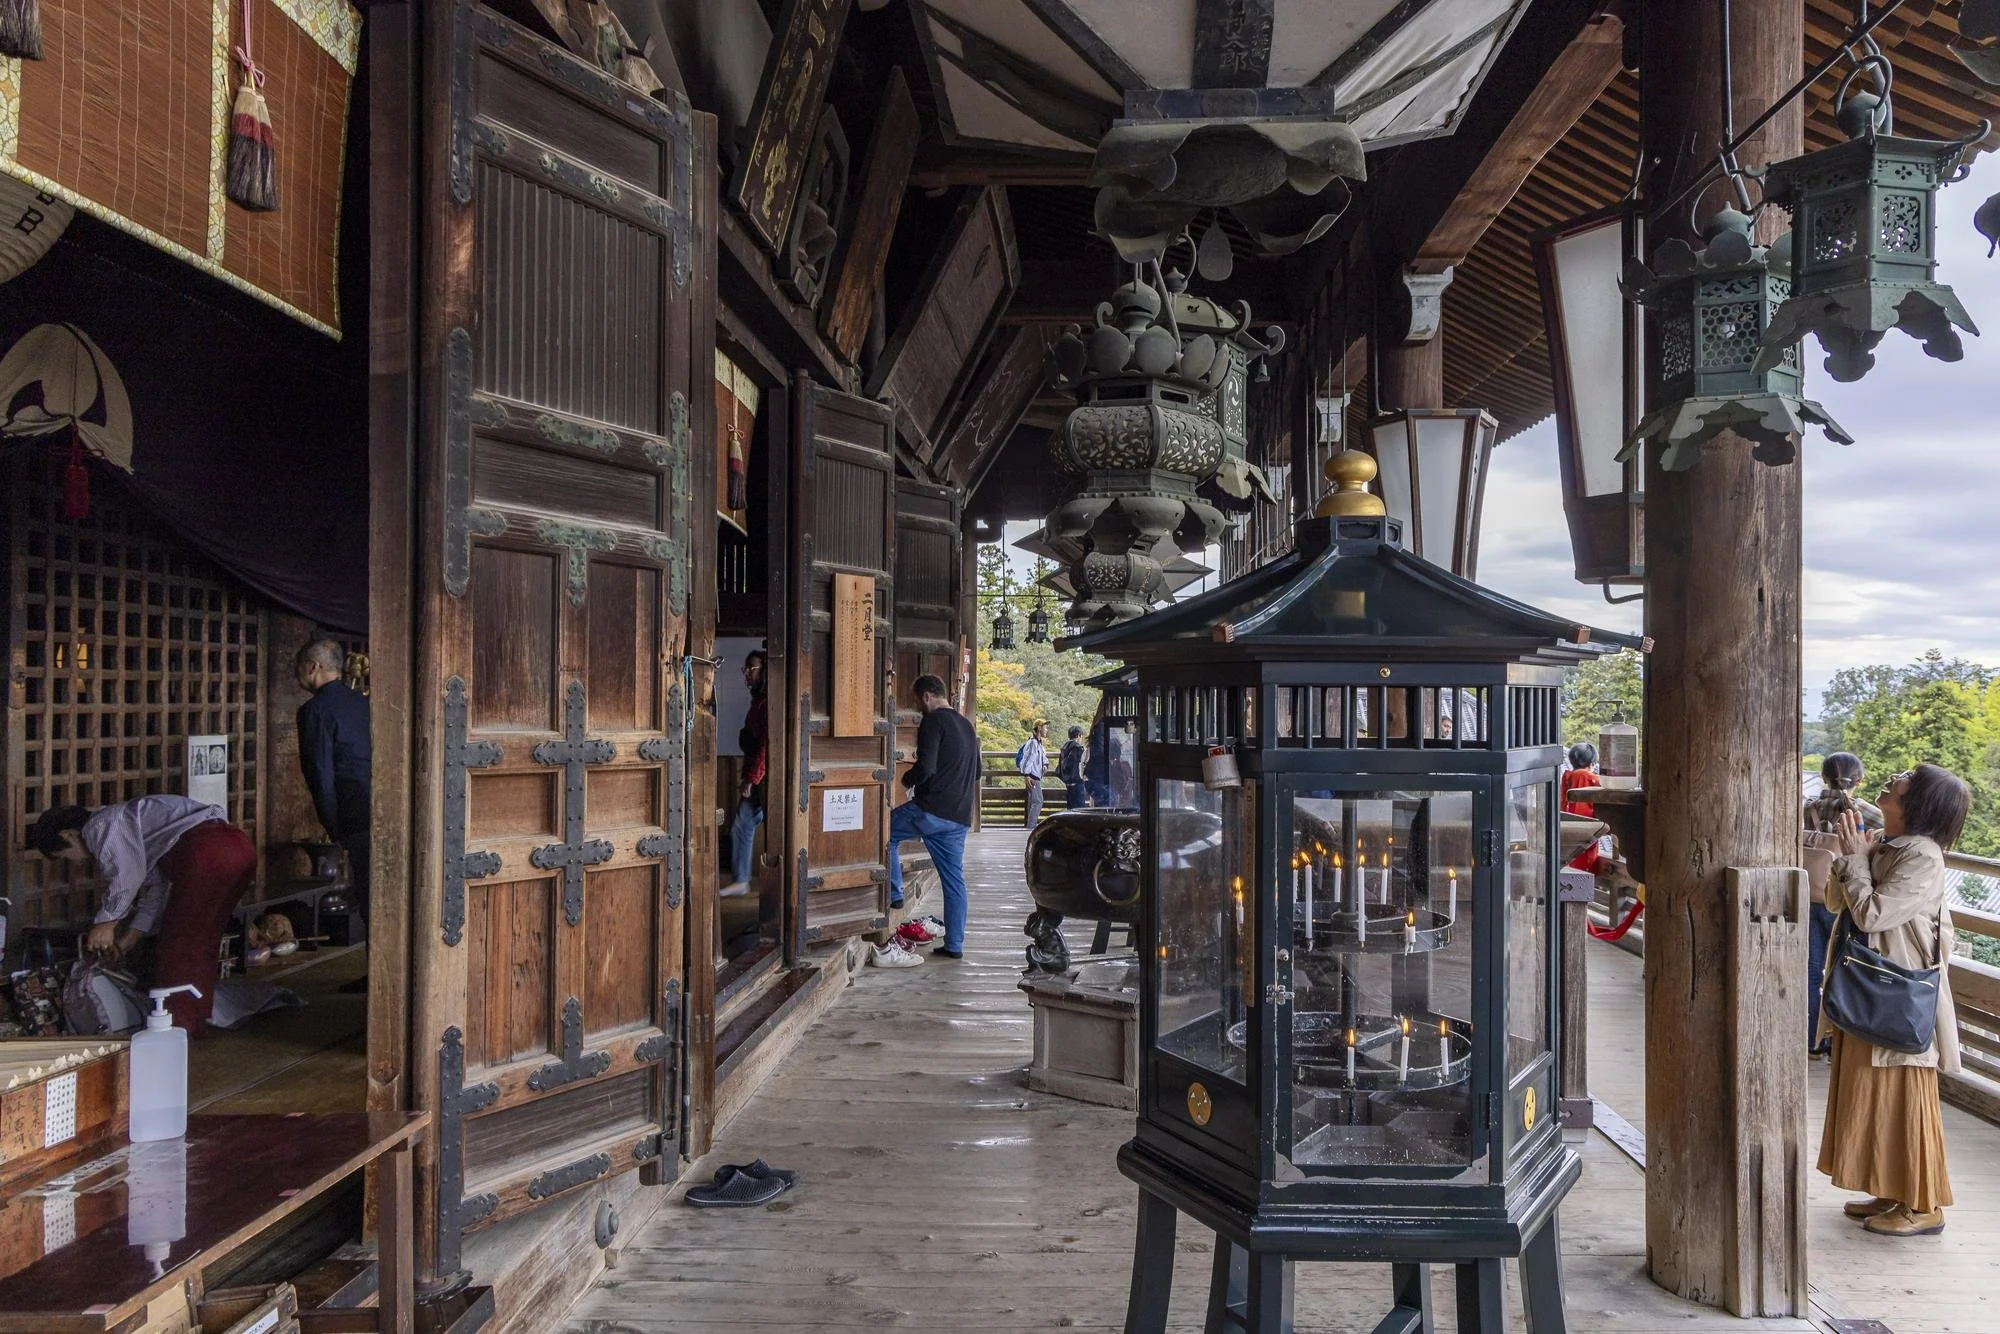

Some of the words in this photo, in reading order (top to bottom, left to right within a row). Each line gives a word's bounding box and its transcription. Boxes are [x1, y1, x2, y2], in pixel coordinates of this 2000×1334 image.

[861, 592, 874, 641] 二月堂
[829, 794, 858, 804] 土足禁止
